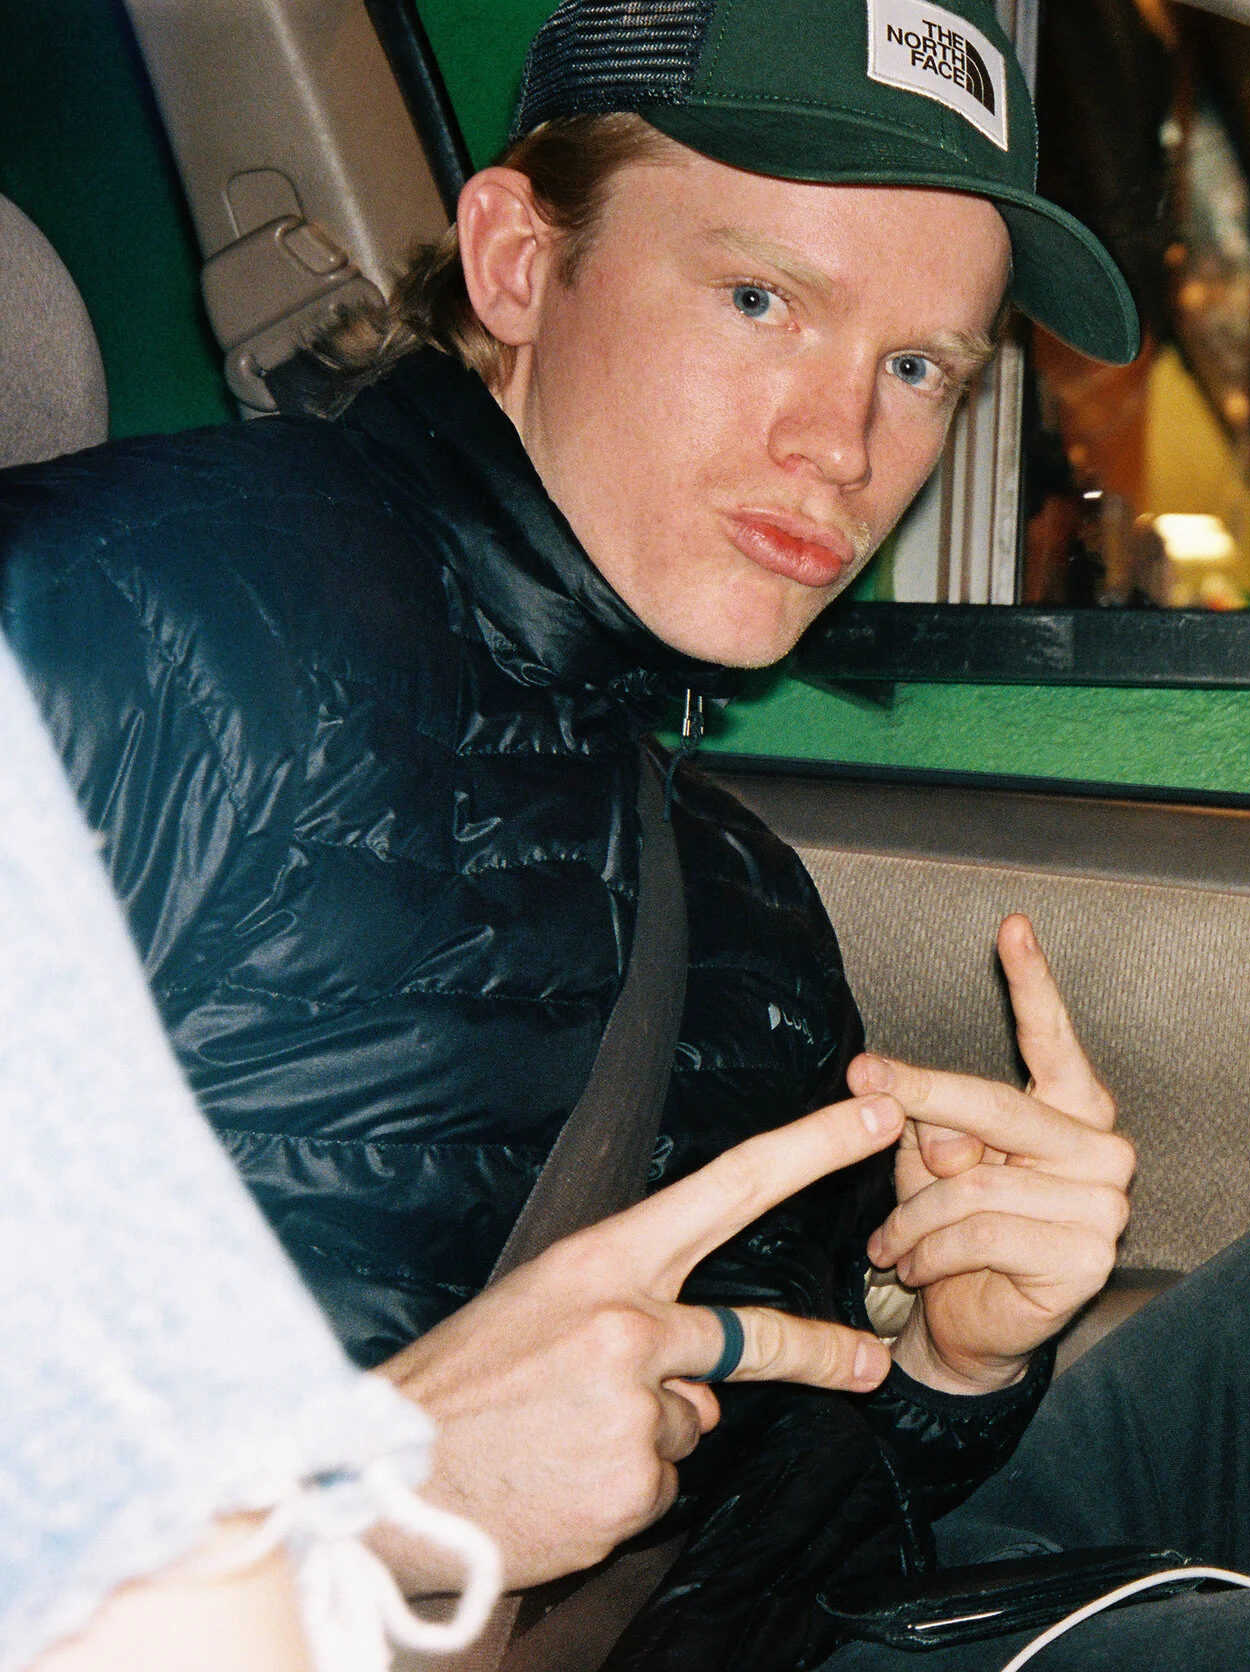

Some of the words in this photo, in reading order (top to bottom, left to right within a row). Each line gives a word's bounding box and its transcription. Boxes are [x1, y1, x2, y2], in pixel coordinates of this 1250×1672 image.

[886, 24, 966, 70] NORTH
[922, 20, 965, 52] THE
[910, 50, 966, 88] FACE
